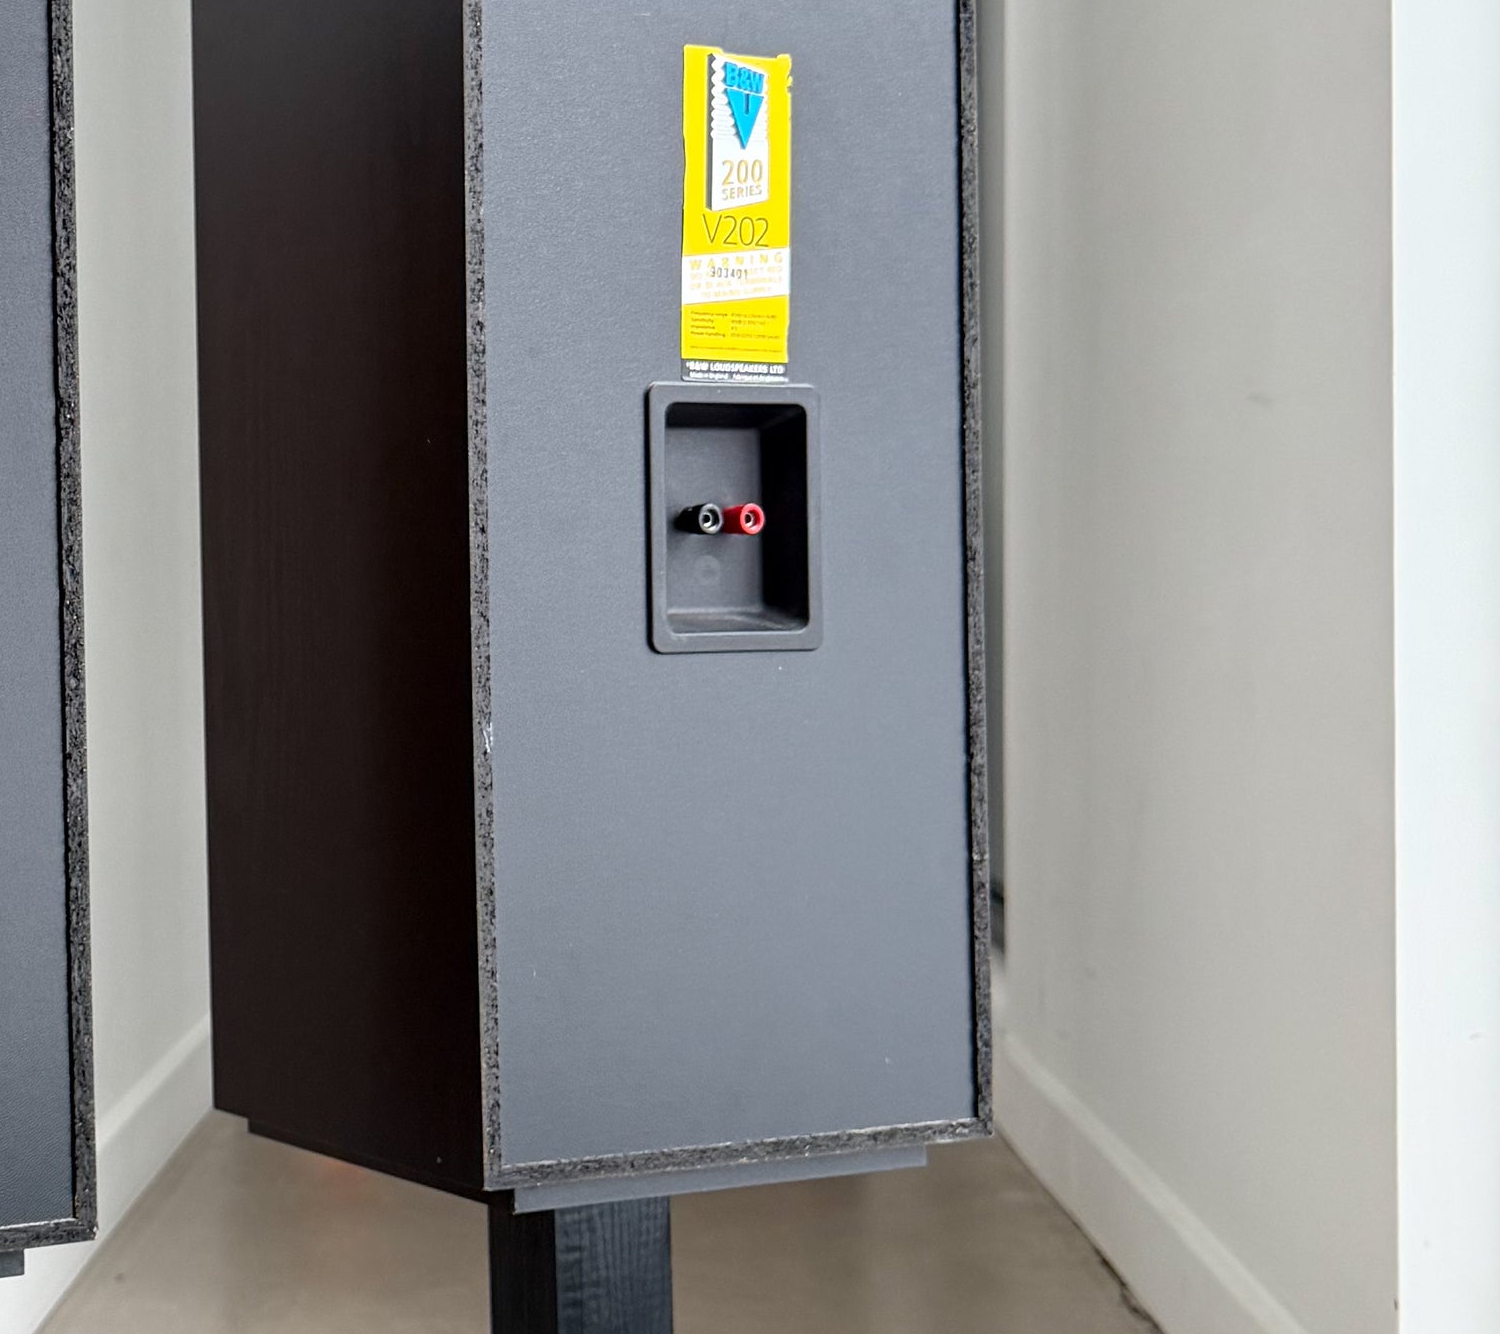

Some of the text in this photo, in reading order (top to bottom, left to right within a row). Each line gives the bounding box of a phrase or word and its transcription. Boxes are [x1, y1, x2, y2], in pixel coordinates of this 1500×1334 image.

[723, 60, 765, 95] B&W
[721, 159, 763, 186] 200
[721, 185, 762, 201] SERIES
[702, 213, 770, 248] V202
